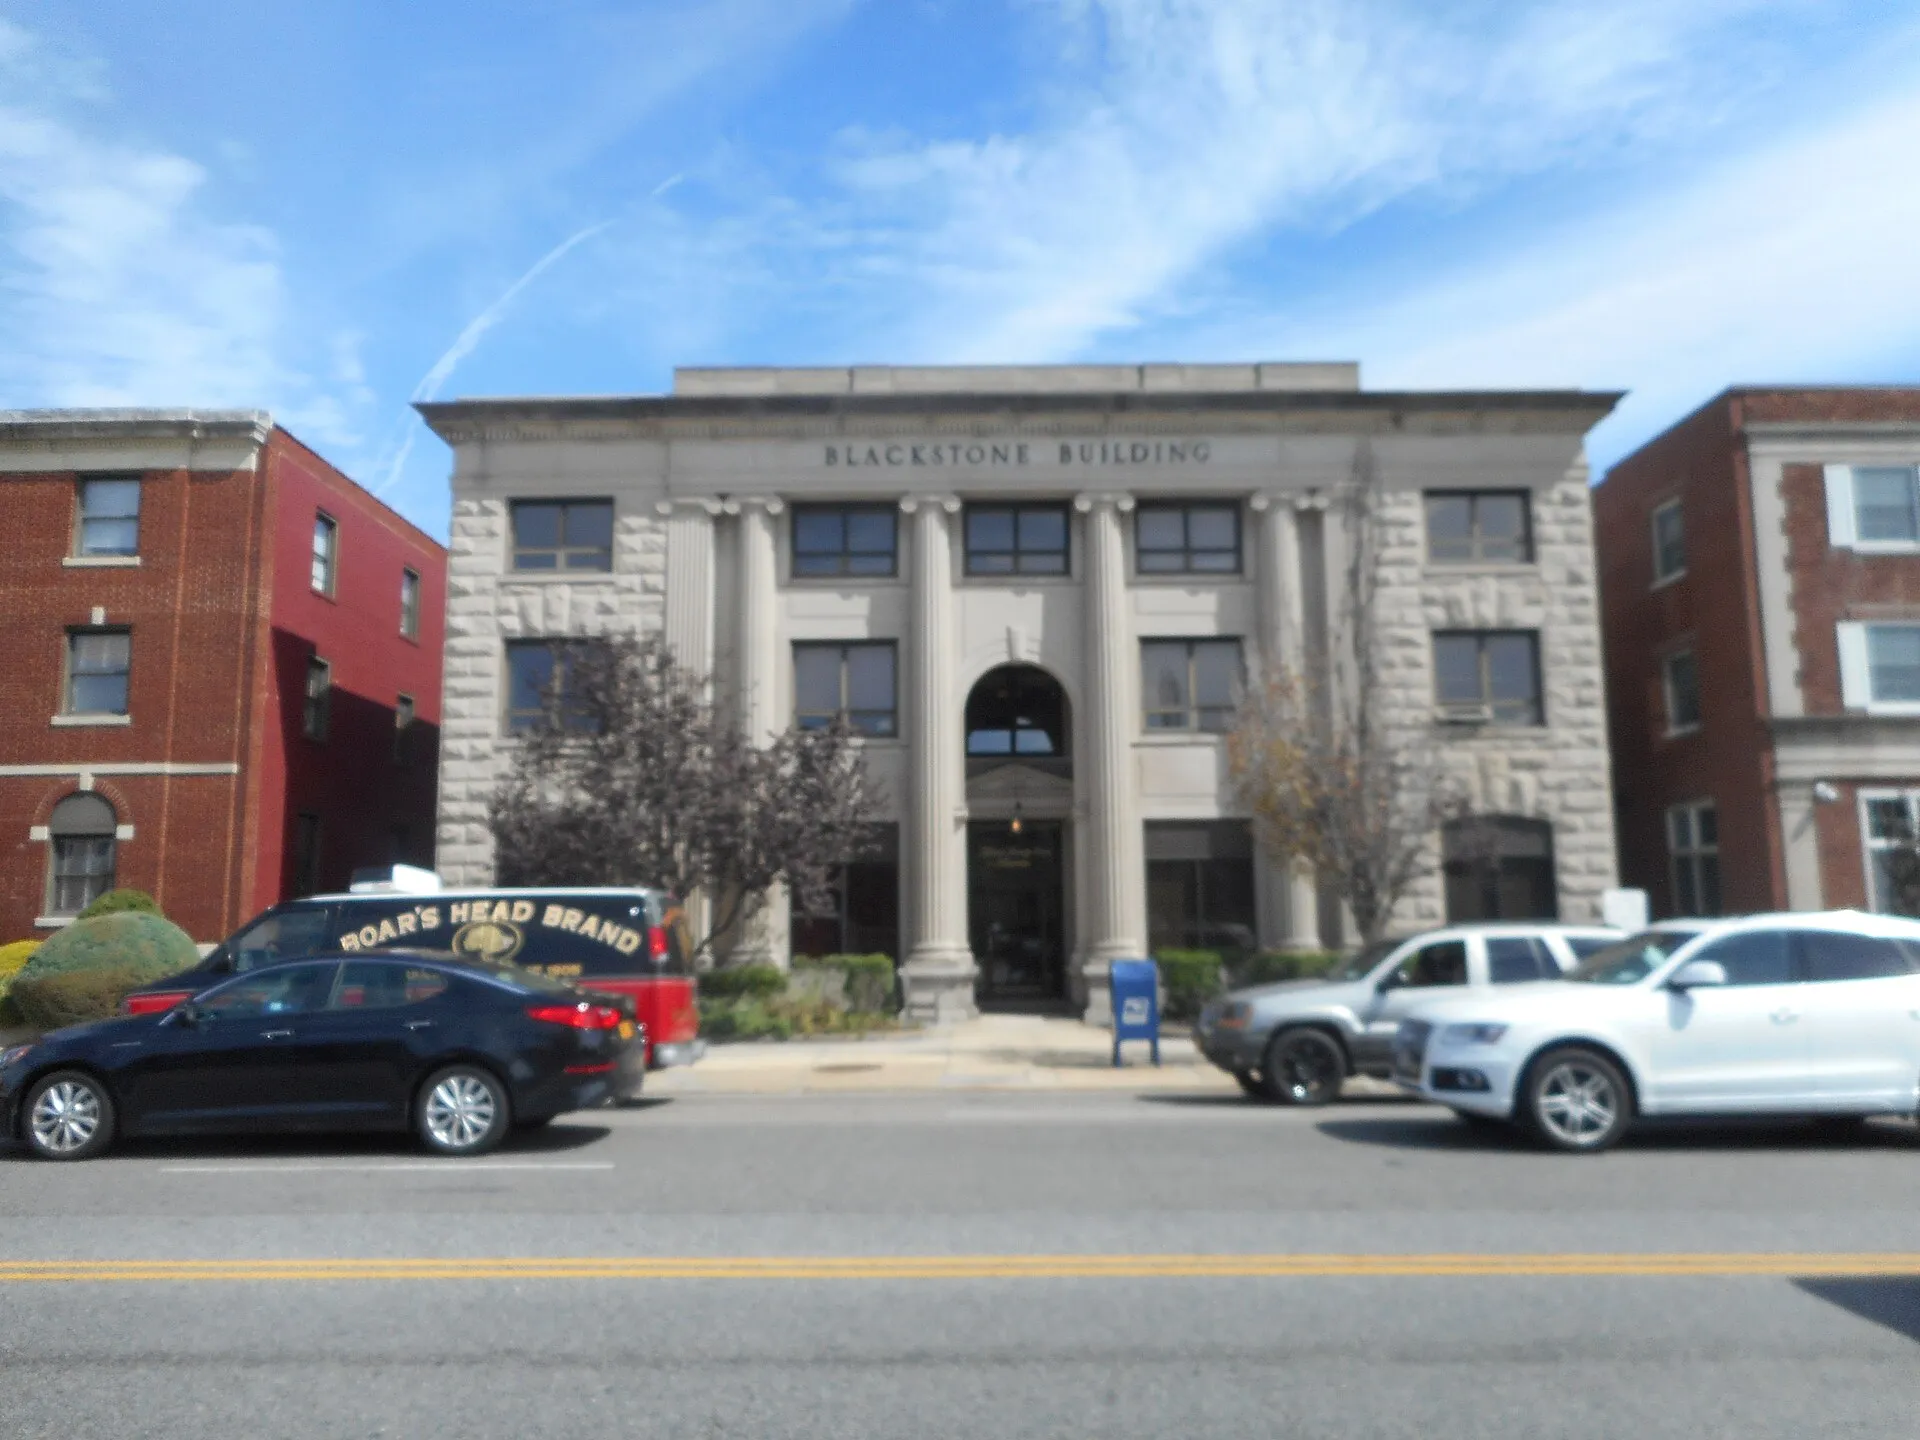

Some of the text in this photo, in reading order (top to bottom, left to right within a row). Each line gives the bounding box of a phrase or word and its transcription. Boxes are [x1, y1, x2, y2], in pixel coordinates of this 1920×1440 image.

[824, 441, 1211, 467] BLACKSTONE BUILDING
[450, 901, 535, 923] HEAD
[542, 905, 641, 955] BRAND
